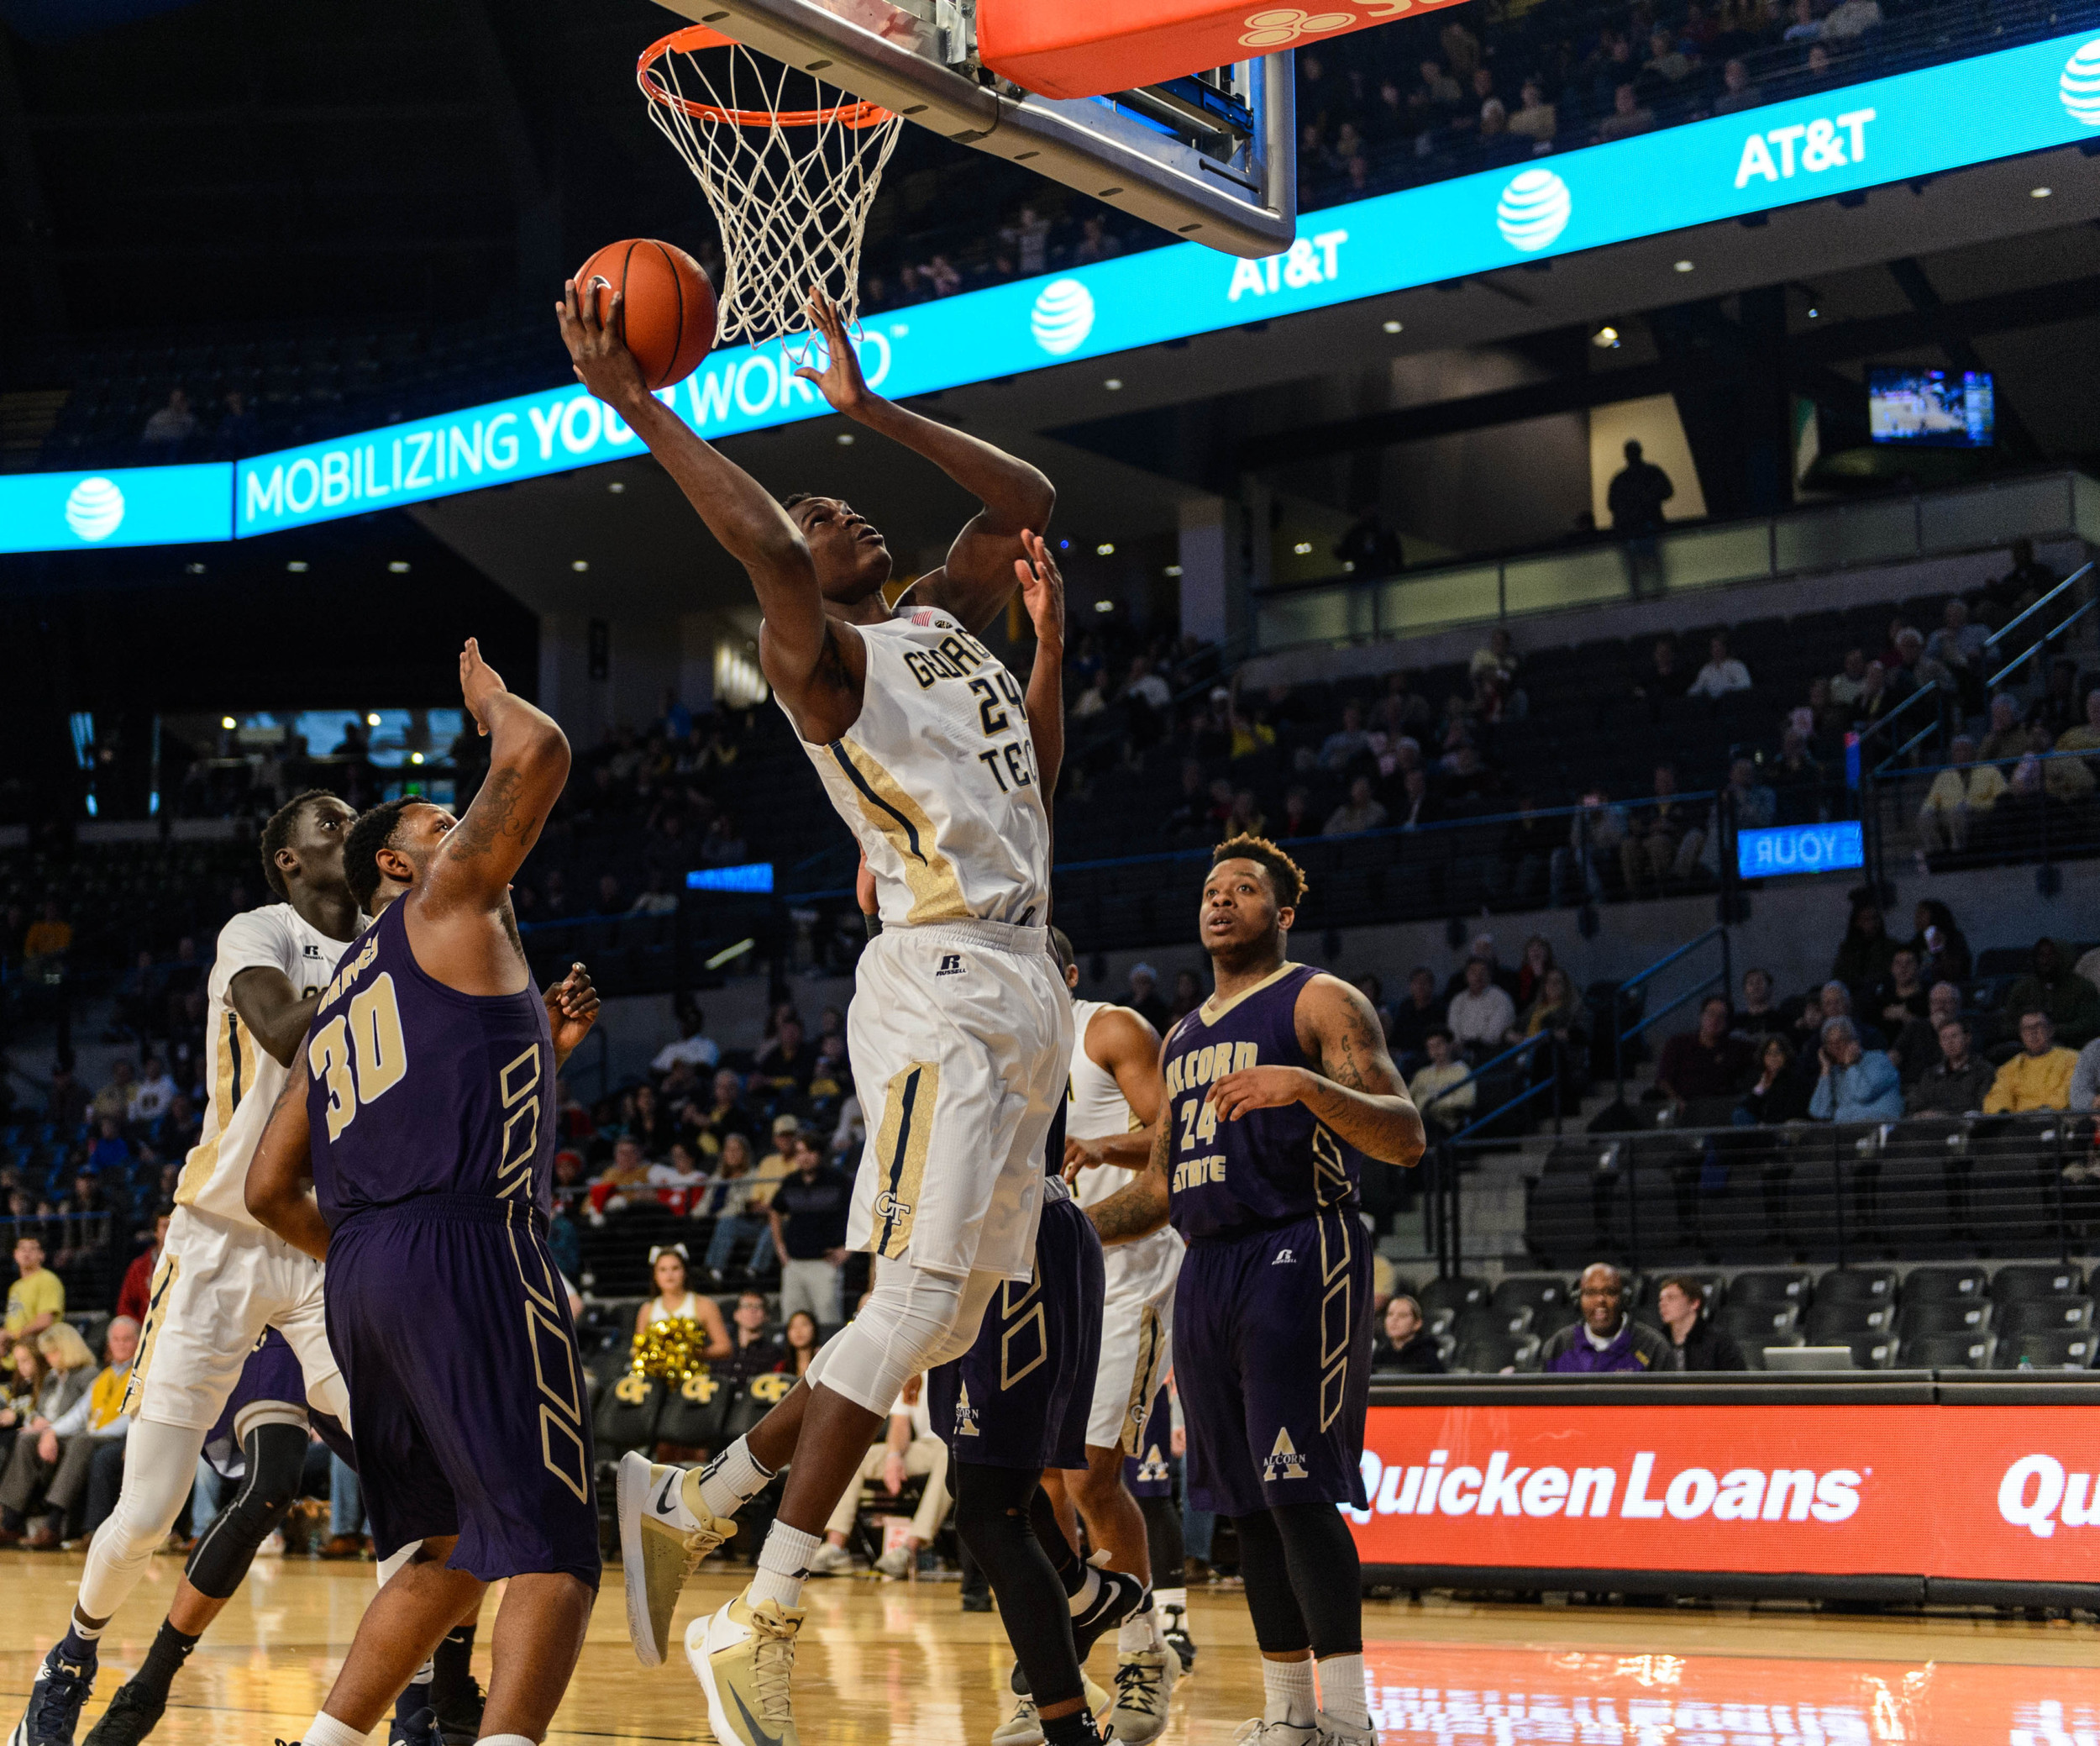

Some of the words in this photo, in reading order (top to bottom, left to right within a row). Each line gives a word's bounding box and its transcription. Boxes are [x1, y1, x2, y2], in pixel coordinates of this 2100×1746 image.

[1734, 107, 1877, 189] AT&T
[245, 413, 519, 523] MOBILIZING
[528, 388, 675, 460] YOU
[967, 672, 1029, 738] 24
[936, 968, 967, 976] RUSSELL
[308, 971, 407, 1144] 30
[1181, 1098, 1217, 1152] 24
[1173, 1155, 1226, 1193] STATE
[874, 1191, 911, 1226] GT
[1263, 1454, 1306, 1467] ALCORN
[1620, 1451, 1862, 1522] Loans
